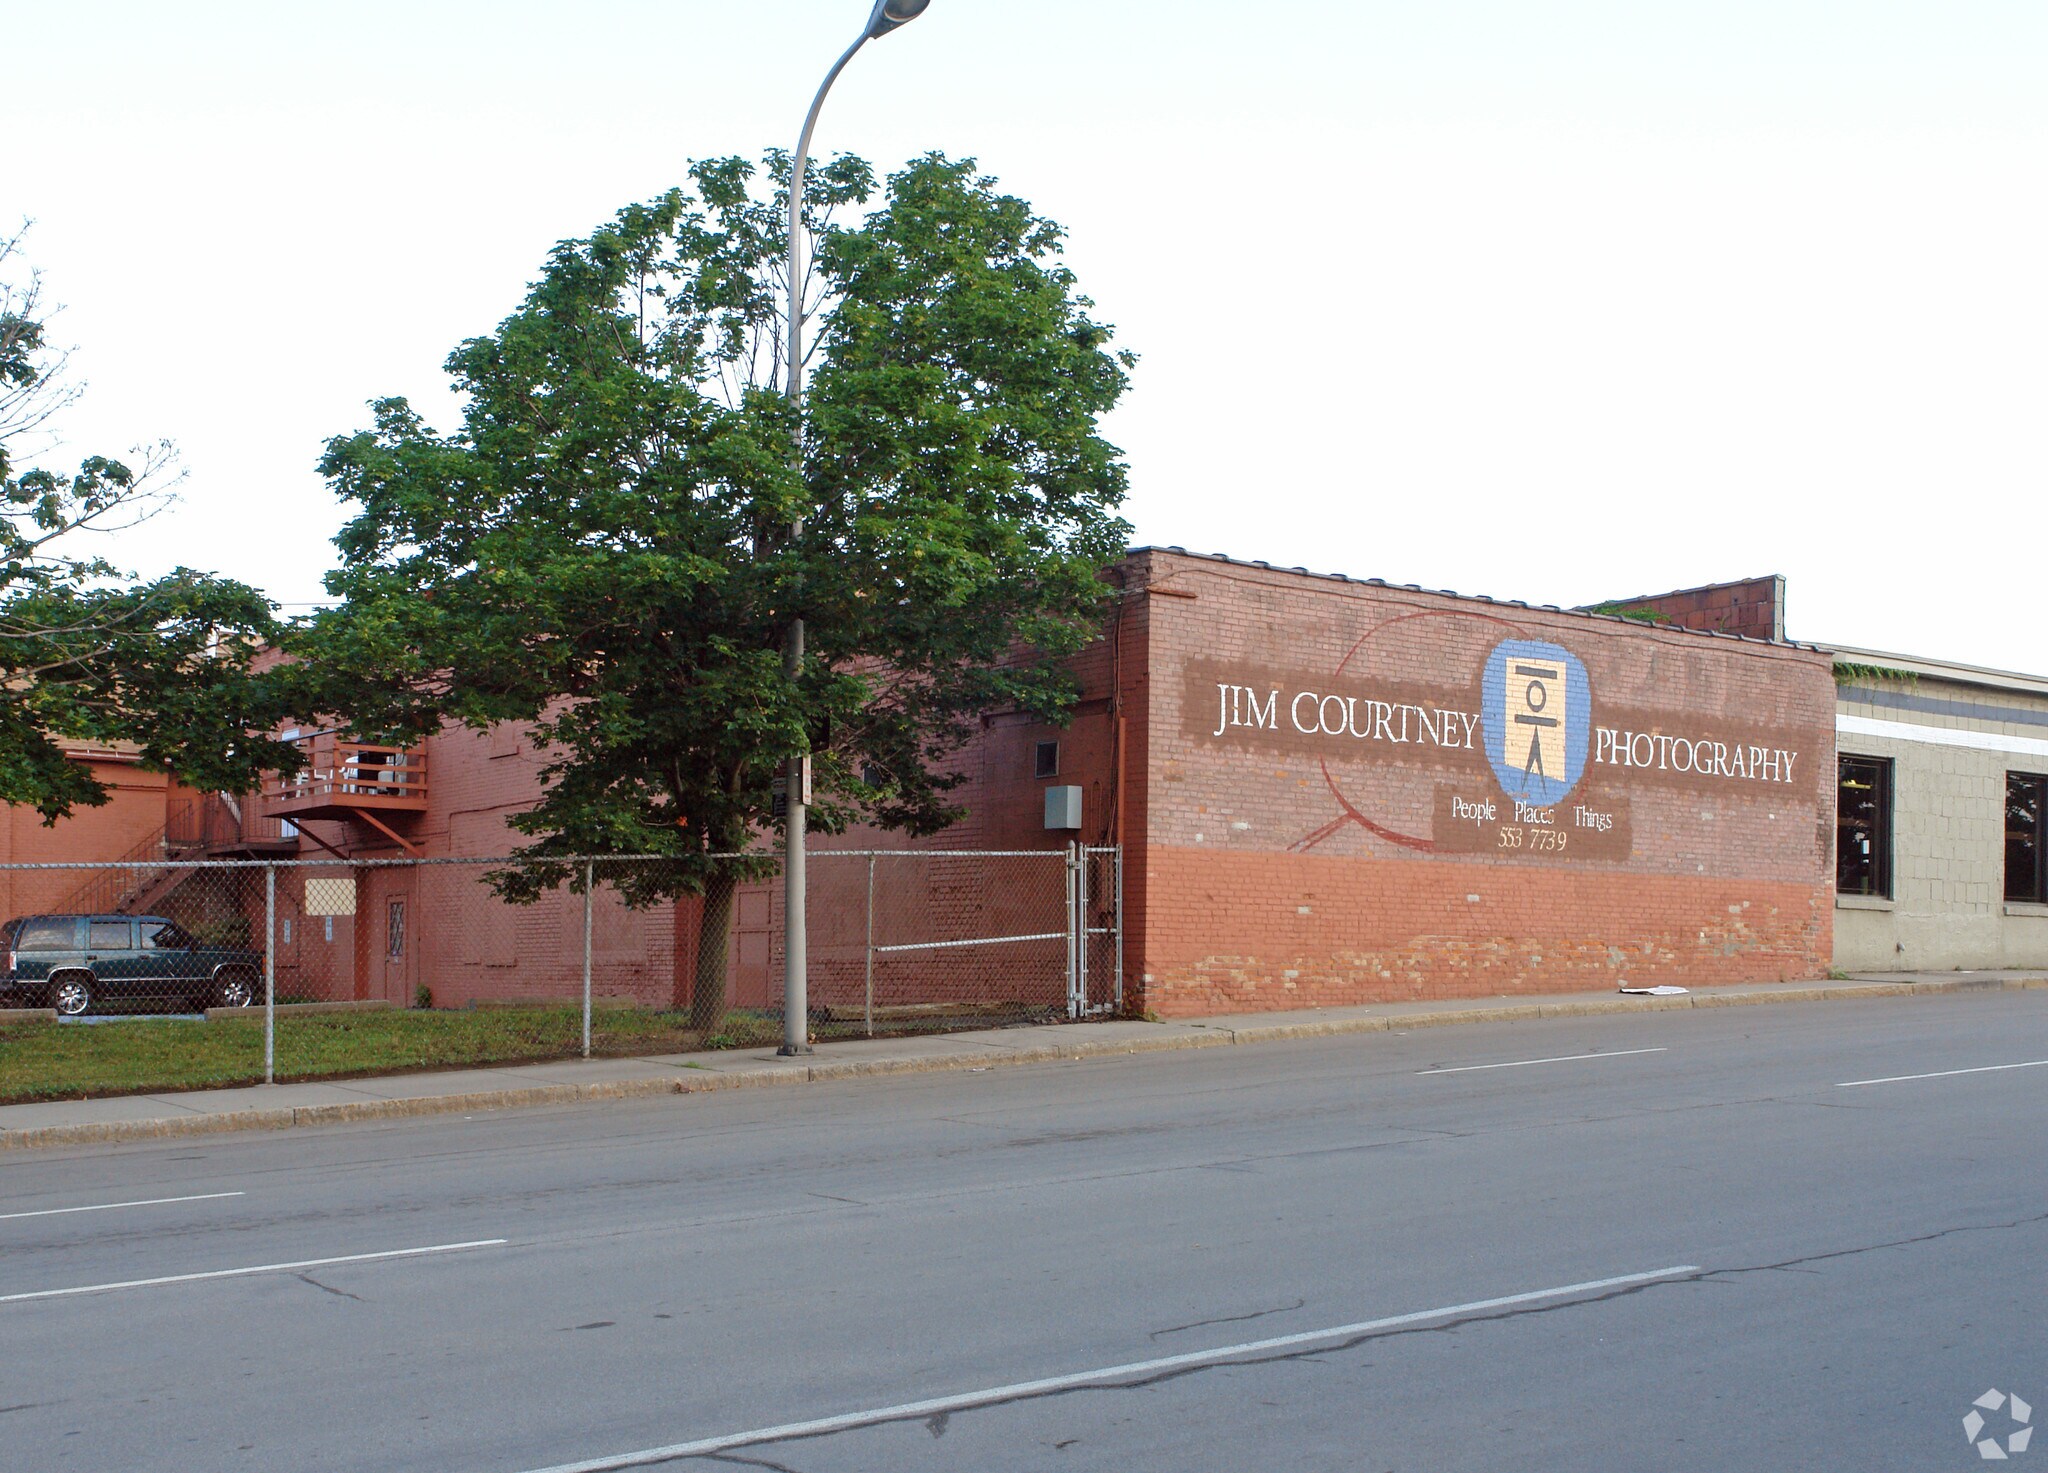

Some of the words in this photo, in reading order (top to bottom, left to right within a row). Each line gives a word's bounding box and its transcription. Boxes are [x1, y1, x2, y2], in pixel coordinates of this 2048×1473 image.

[1213, 684, 1279, 737] JIM
[1291, 692, 1480, 749] COURTNEY
[1595, 728, 1798, 783] PHOTOGRAPHY
[1452, 797, 1497, 827] People
[1573, 805, 1613, 832] Things
[1498, 826, 1523, 848] 553
[1529, 828, 1567, 852] 7739
